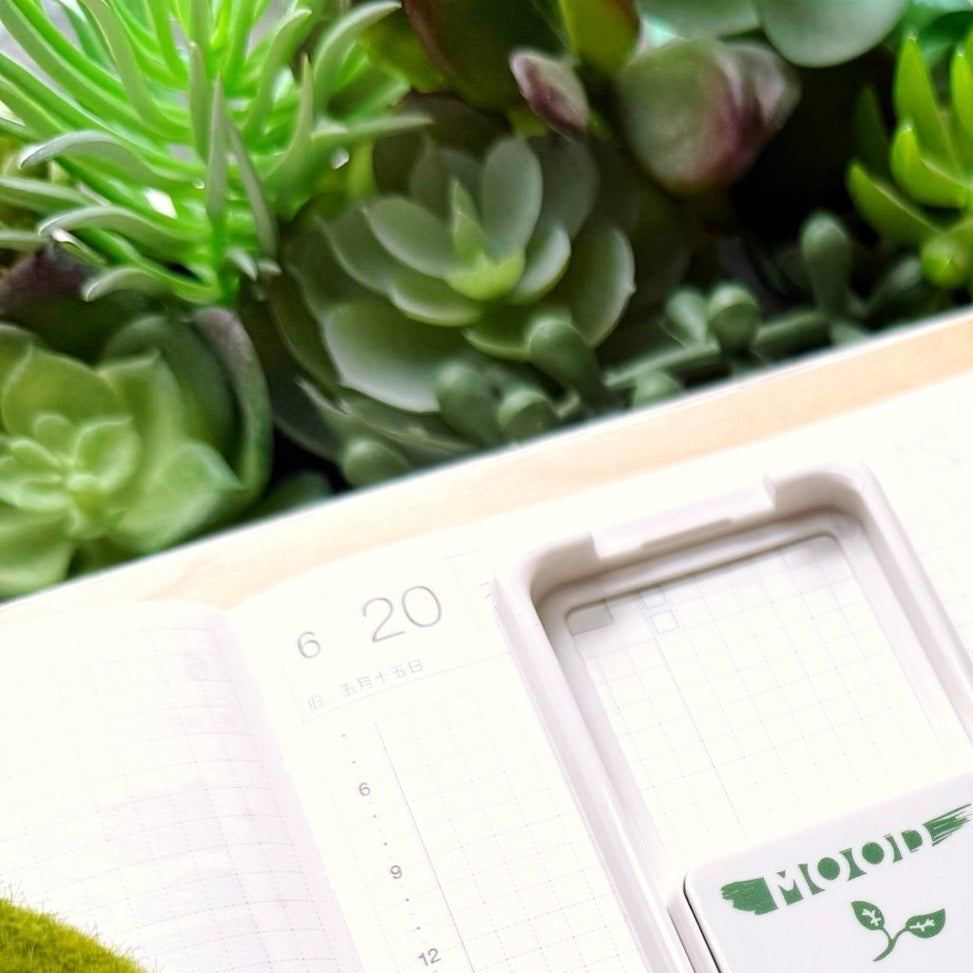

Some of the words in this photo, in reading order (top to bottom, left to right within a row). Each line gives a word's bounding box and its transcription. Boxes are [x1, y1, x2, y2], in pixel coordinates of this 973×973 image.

[297, 631, 321, 659] 6
[362, 585, 443, 643] 20
[358, 782, 371, 796] 6
[390, 865, 403, 880] 9
[762, 824, 934, 909] MOOD
[418, 948, 441, 967] 12
